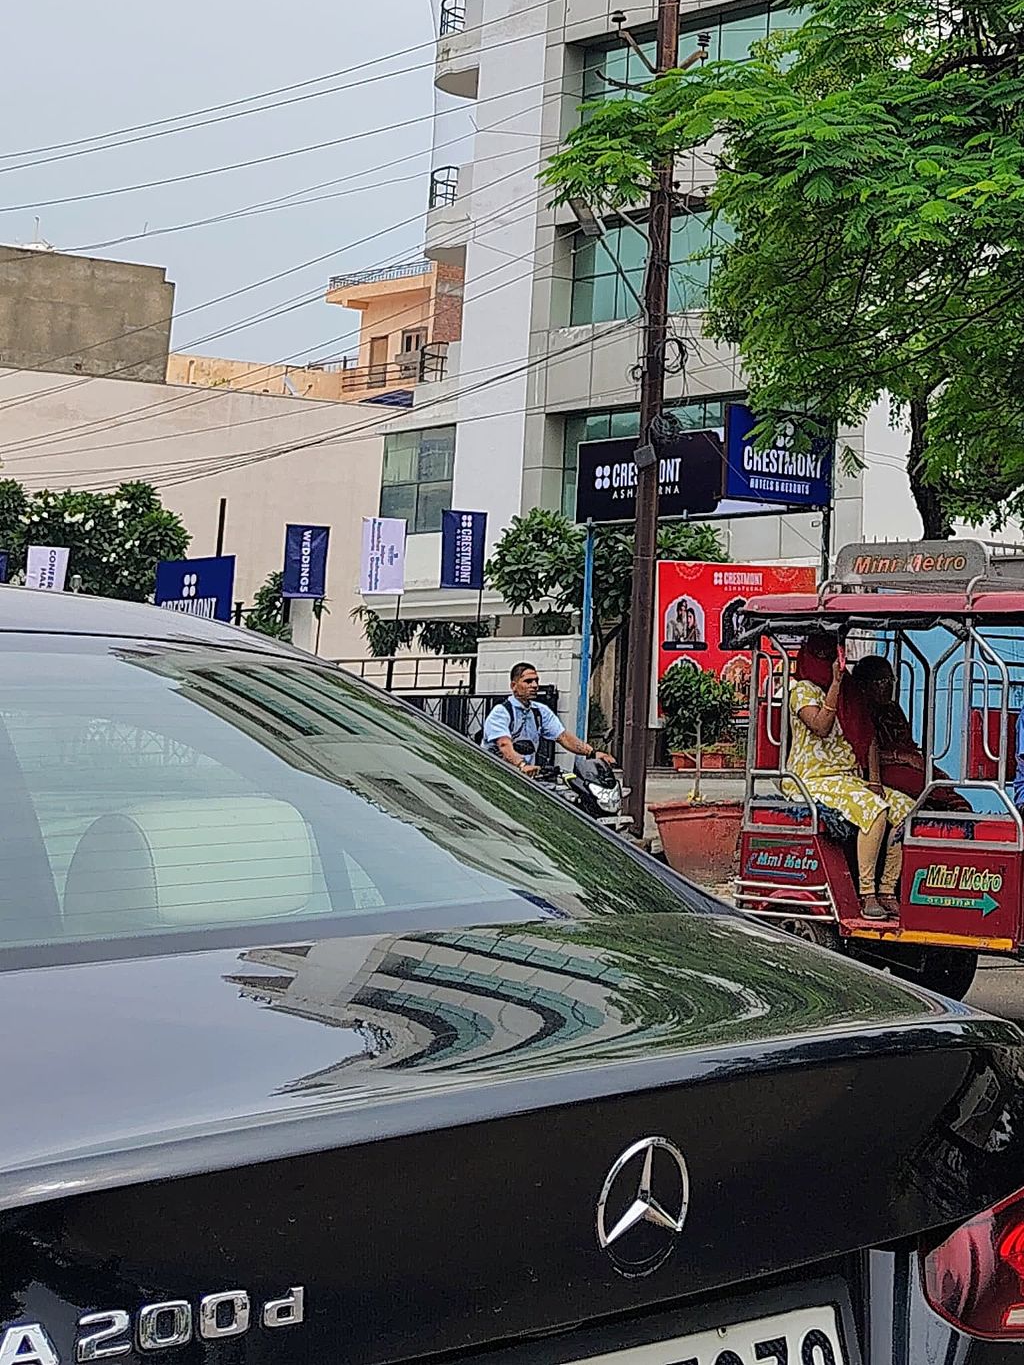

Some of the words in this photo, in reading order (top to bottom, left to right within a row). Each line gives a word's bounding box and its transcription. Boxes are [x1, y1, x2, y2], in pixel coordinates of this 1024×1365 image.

[612, 485, 680, 499] ASHRNA
[300, 529, 313, 593] WEDDINGS
[460, 528, 473, 584] CRESTMONT
[854, 555, 898, 574] Mini
[903, 553, 967, 573] Metro
[723, 572, 763, 586] CRESTMONT
[784, 854, 819, 871] Metro
[926, 865, 960, 888] Mini
[959, 866, 1002, 892] Metro
